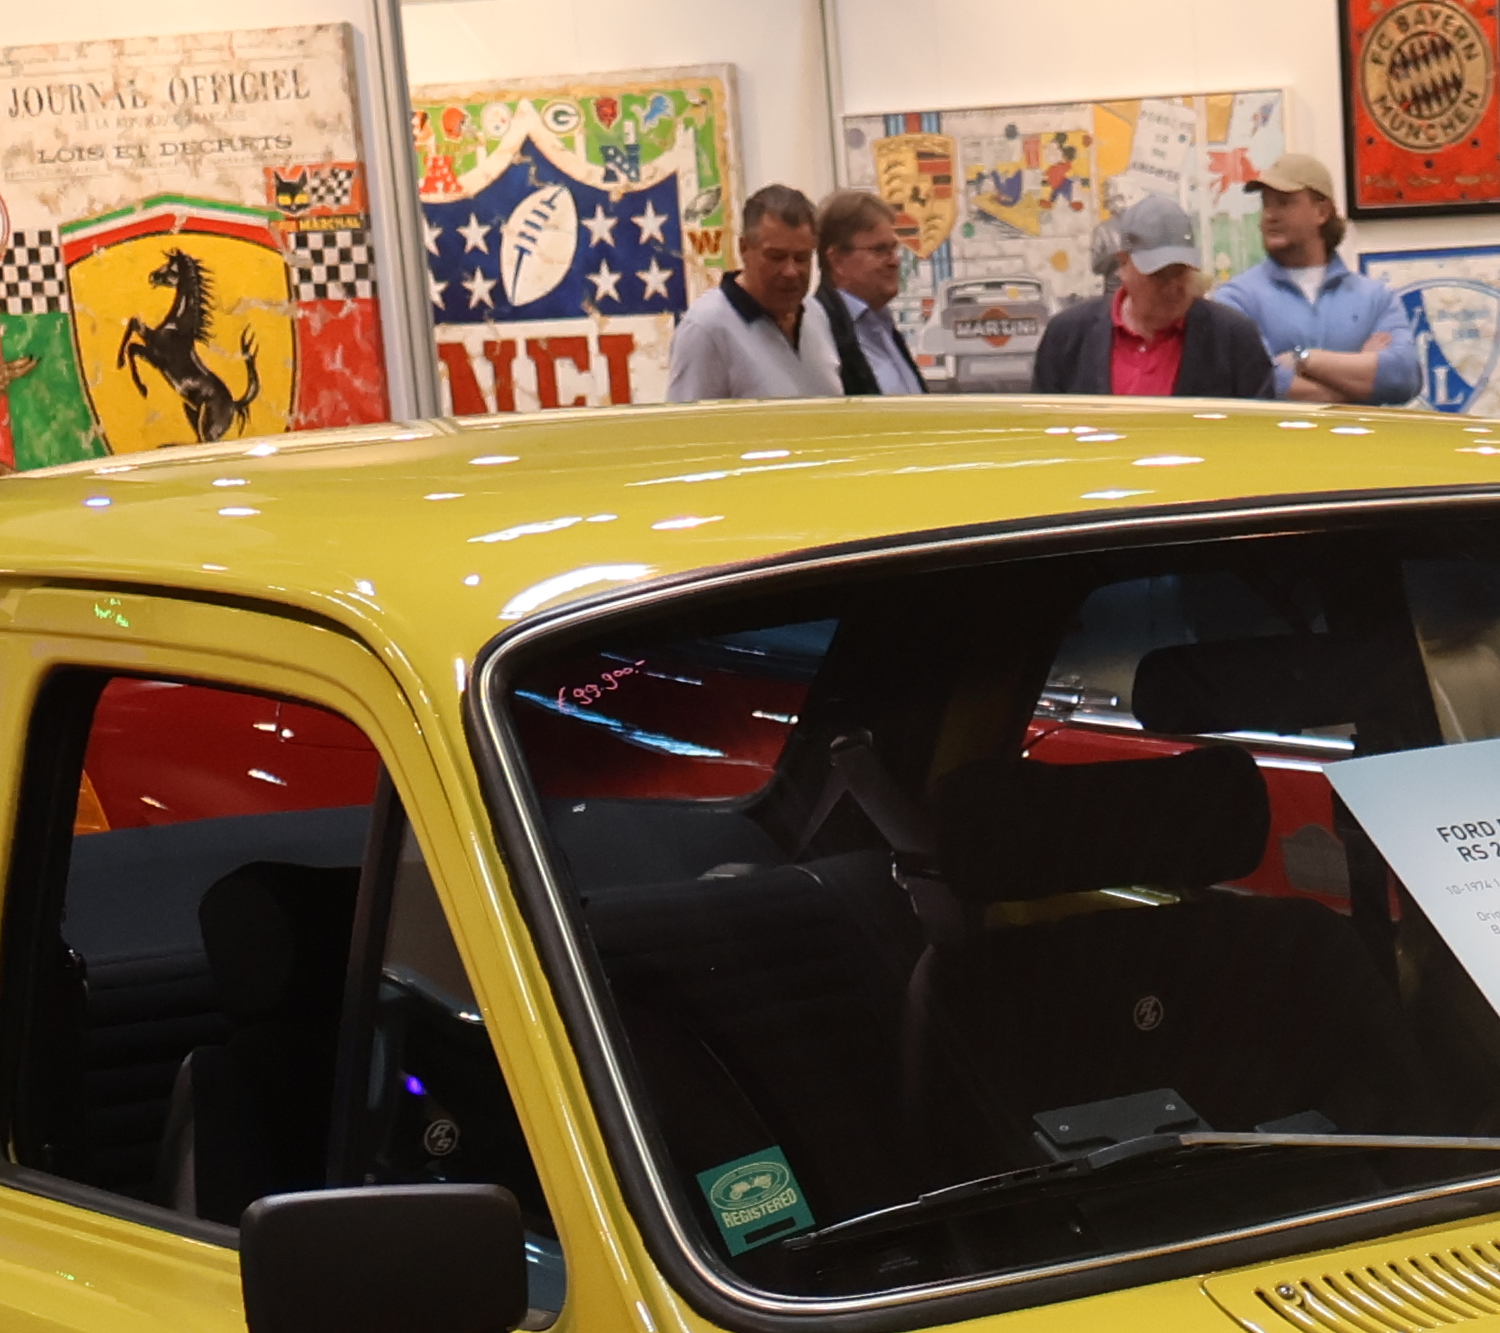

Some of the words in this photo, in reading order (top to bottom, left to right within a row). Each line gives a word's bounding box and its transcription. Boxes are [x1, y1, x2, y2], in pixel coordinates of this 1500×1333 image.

[1395, 8, 1480, 61] BAYERN
[168, 67, 312, 107] OFFICIEL
[37, 143, 105, 165] LOIS
[1436, 819, 1497, 844] FORD
[1456, 843, 1490, 864] RS
[720, 1186, 798, 1230] REGISTERED
